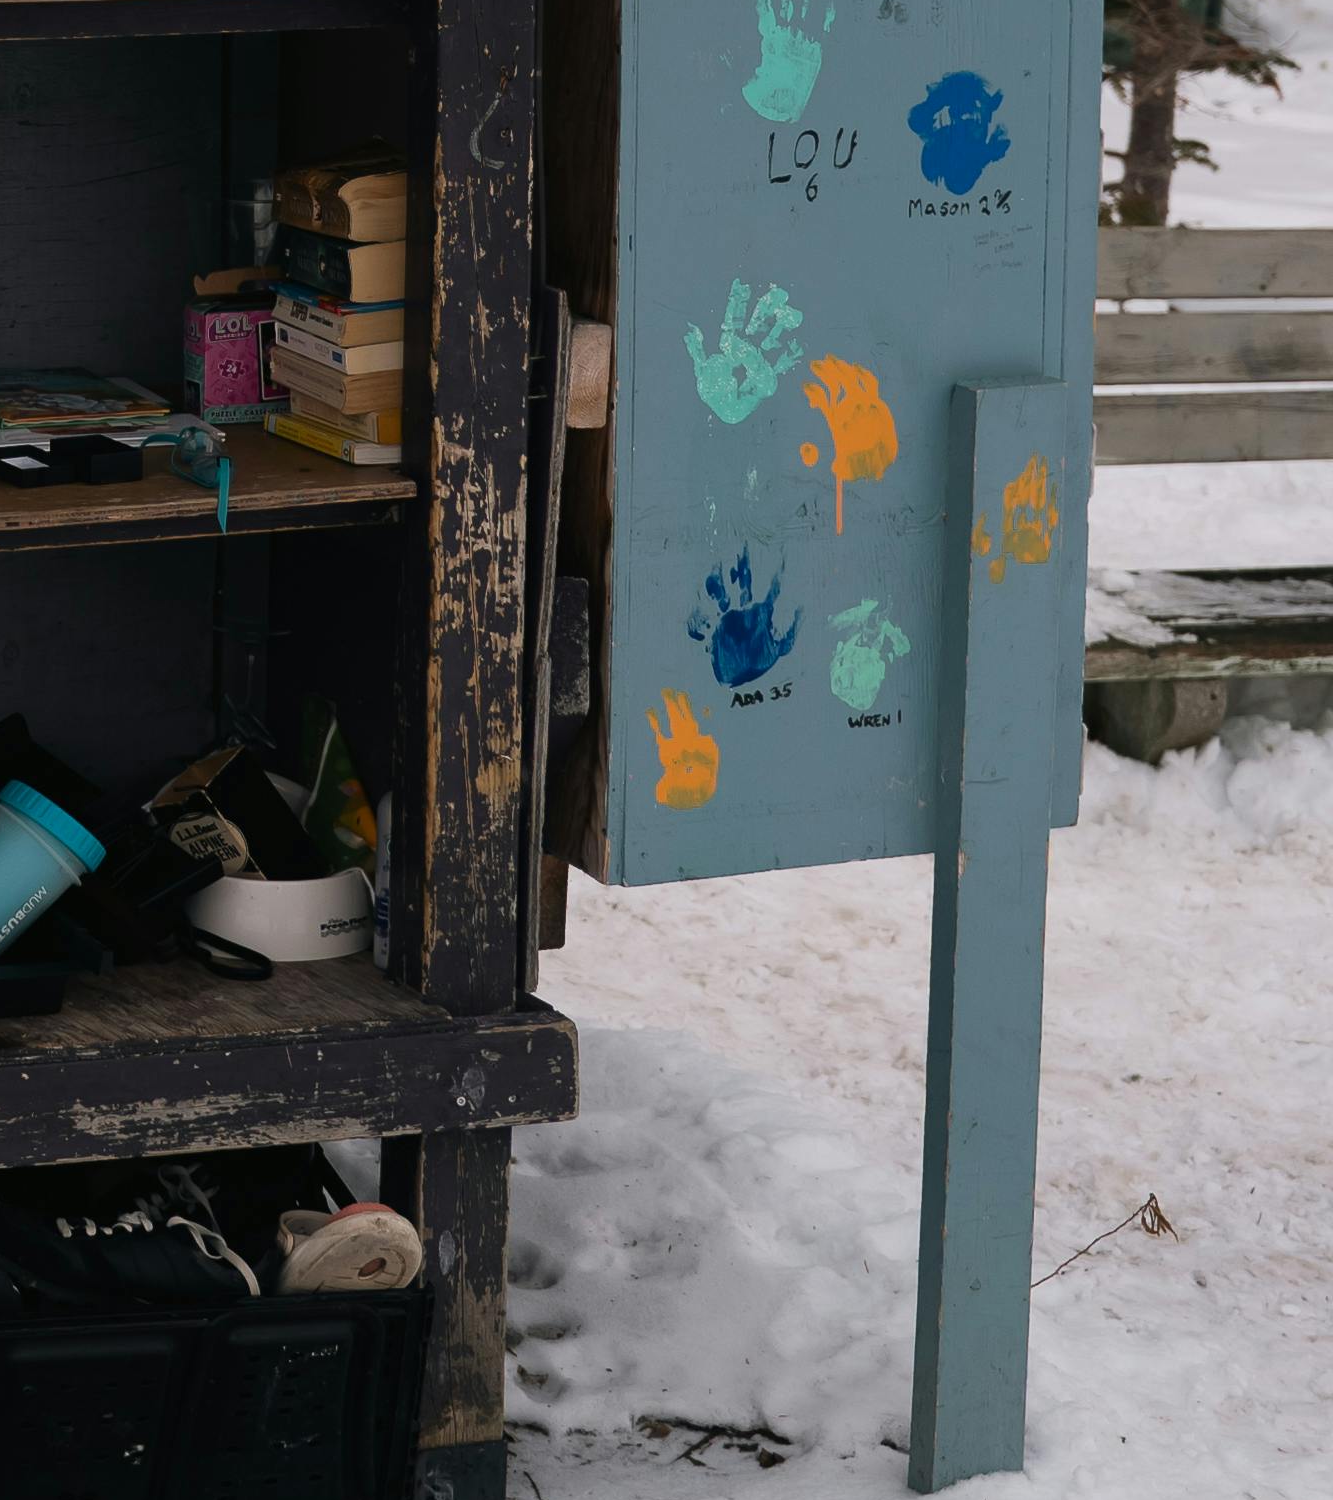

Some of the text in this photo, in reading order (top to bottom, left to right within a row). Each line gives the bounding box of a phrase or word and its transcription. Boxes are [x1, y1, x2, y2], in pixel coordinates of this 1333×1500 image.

[767, 127, 857, 184] LOU
[805, 173, 819, 202] 6
[908, 198, 971, 218] Mason
[214, 316, 252, 334] LOL
[847, 713, 890, 728] WREN
[188, 833, 230, 856] ALPINE
